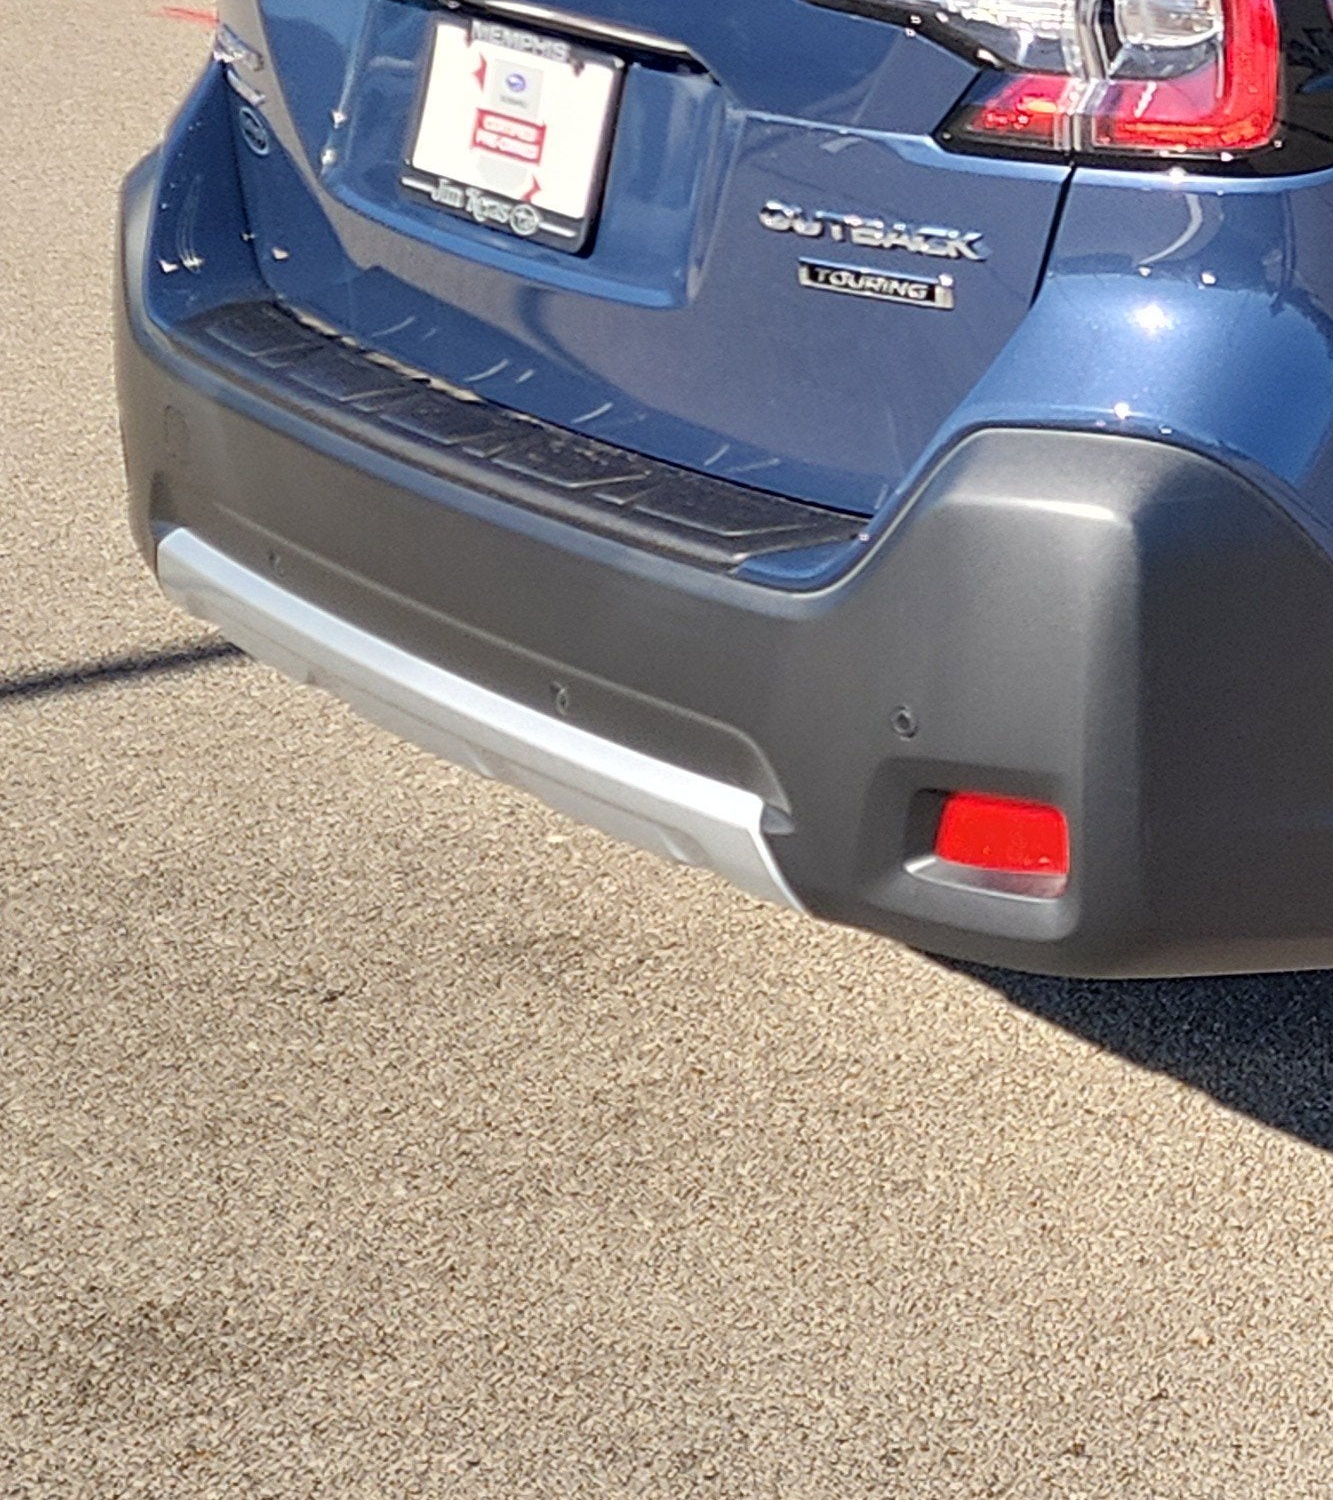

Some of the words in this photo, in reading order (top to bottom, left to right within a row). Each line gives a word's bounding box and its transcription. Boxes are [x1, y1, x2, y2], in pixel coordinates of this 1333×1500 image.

[472, 20, 569, 63] MEMPHIS
[759, 199, 988, 261] OUTBACK
[814, 266, 930, 300] TOURING
